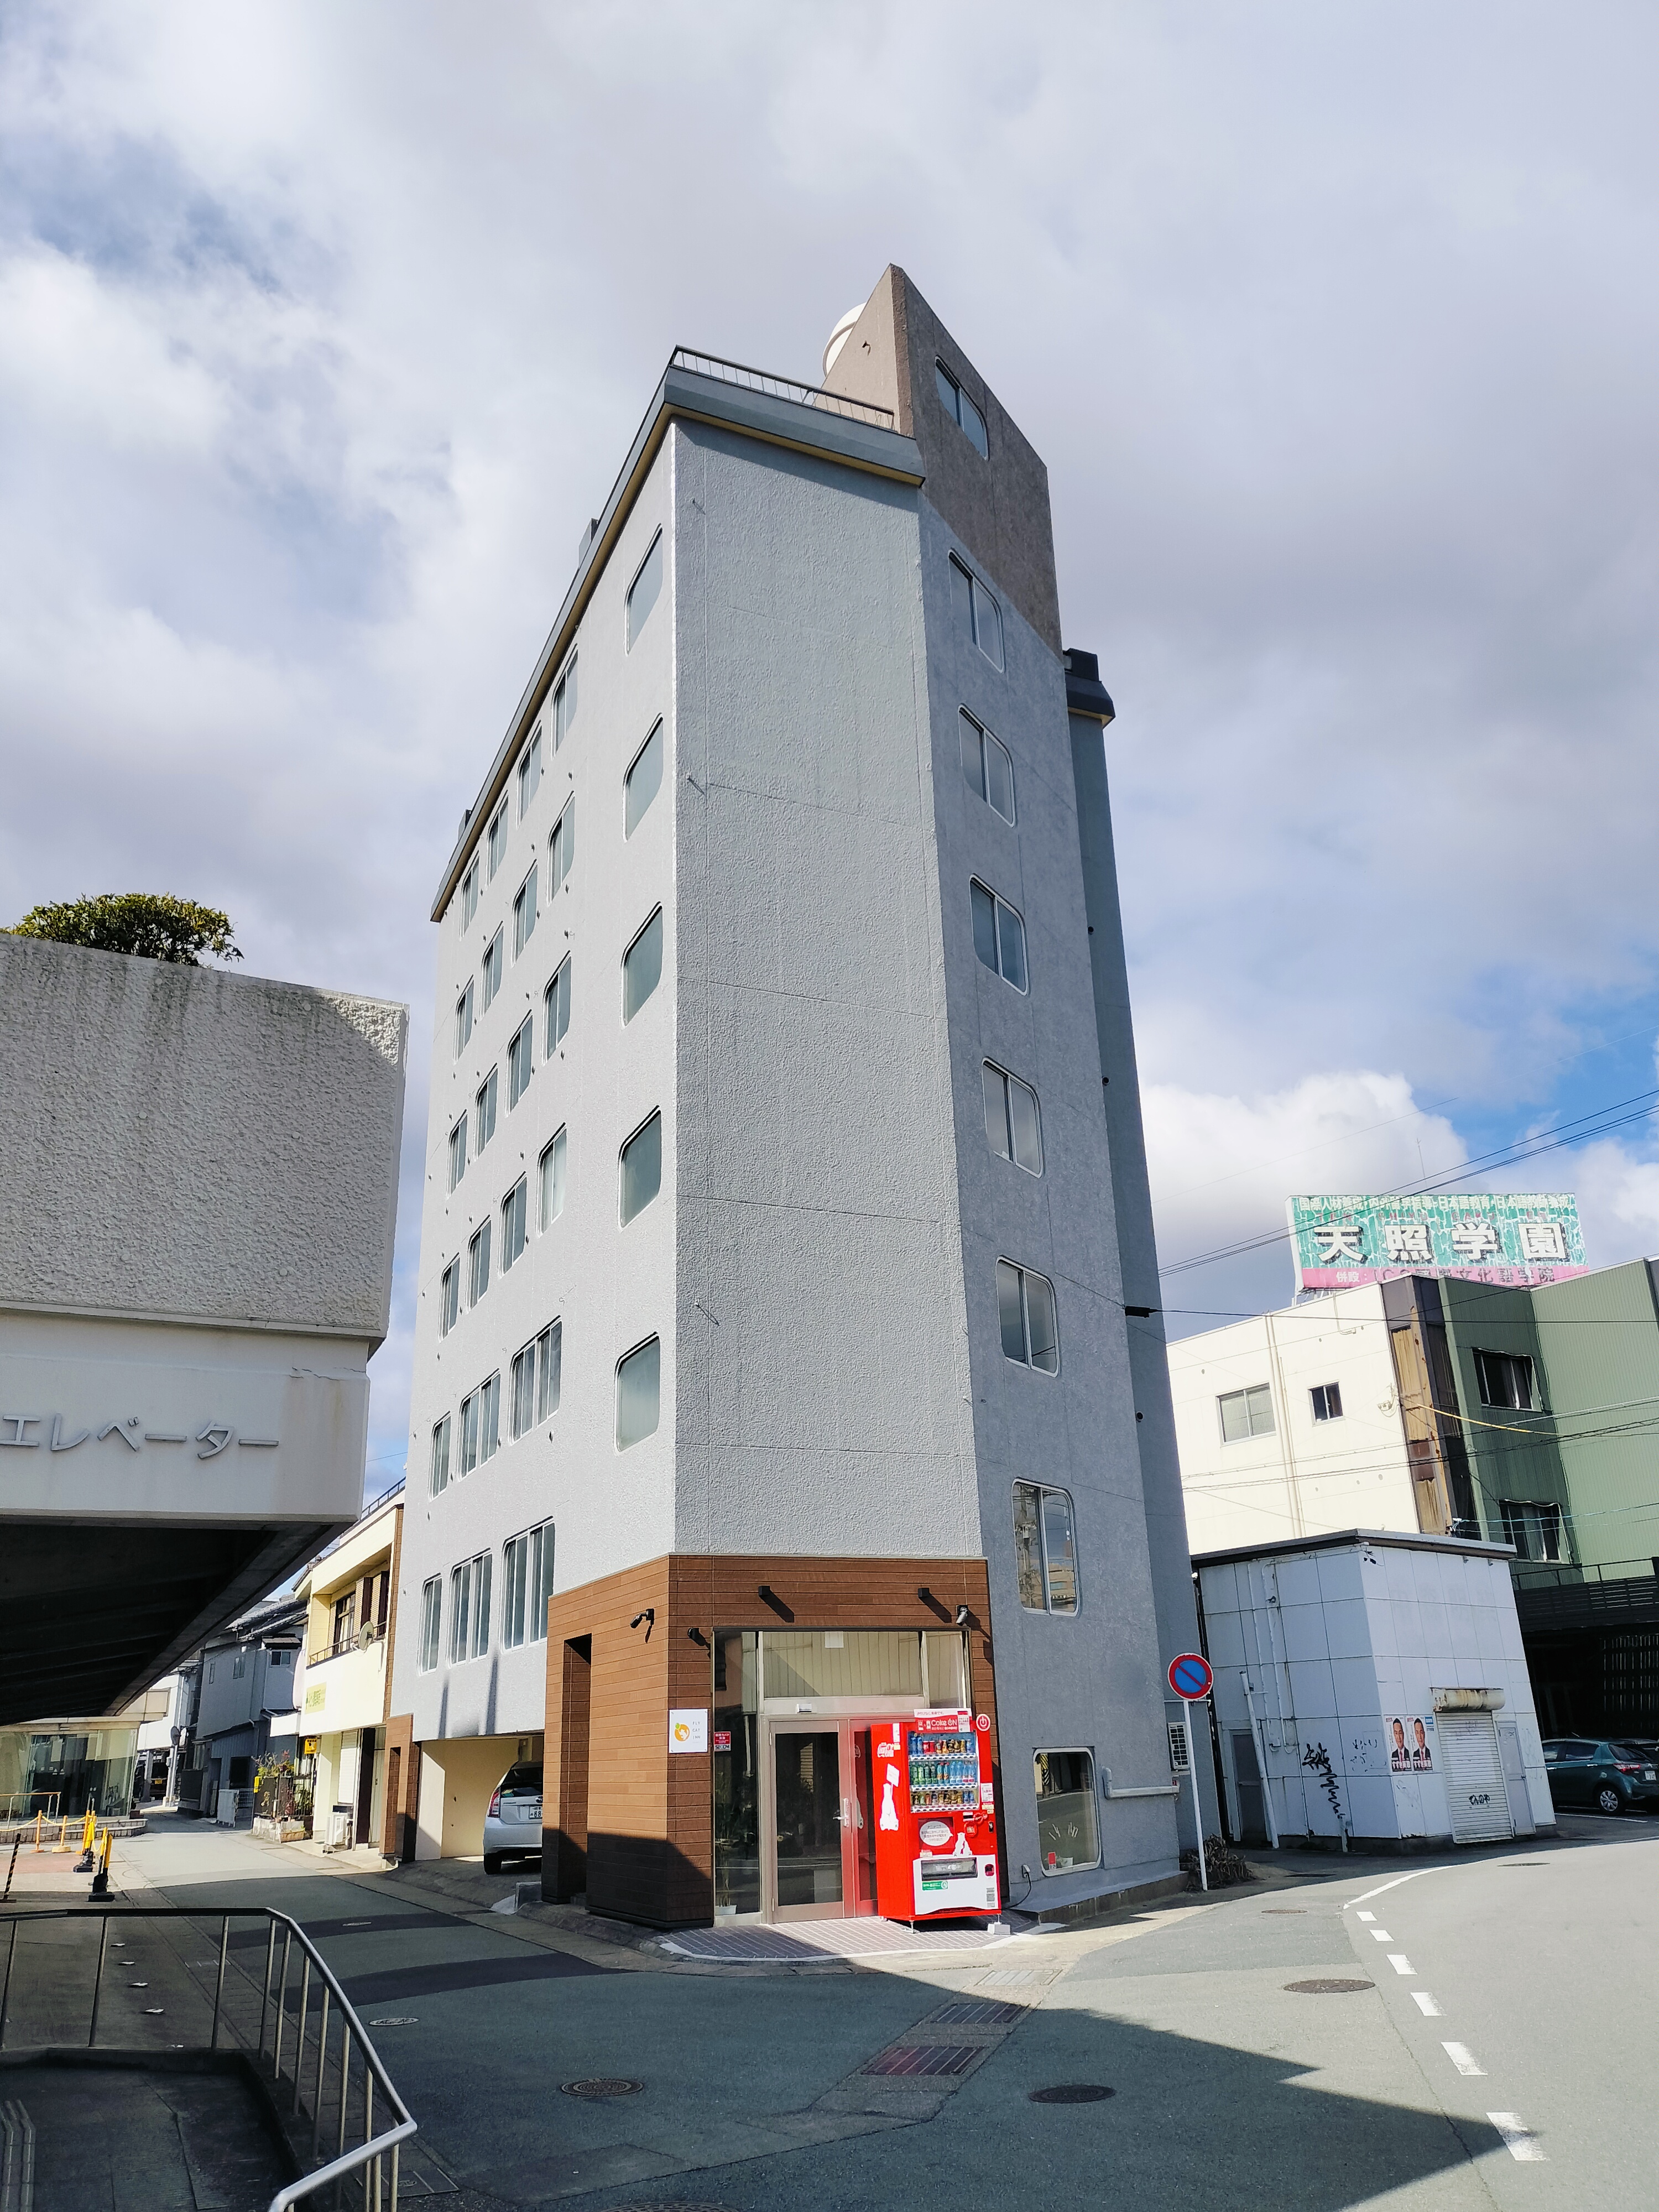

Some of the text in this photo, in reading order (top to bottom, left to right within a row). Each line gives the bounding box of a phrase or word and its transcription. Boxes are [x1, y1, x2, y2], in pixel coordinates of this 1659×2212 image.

[1314, 1223, 1569, 1263] 天照学園
[0, 1413, 279, 1459] エレベーター
[947, 1718, 957, 1726] ON
